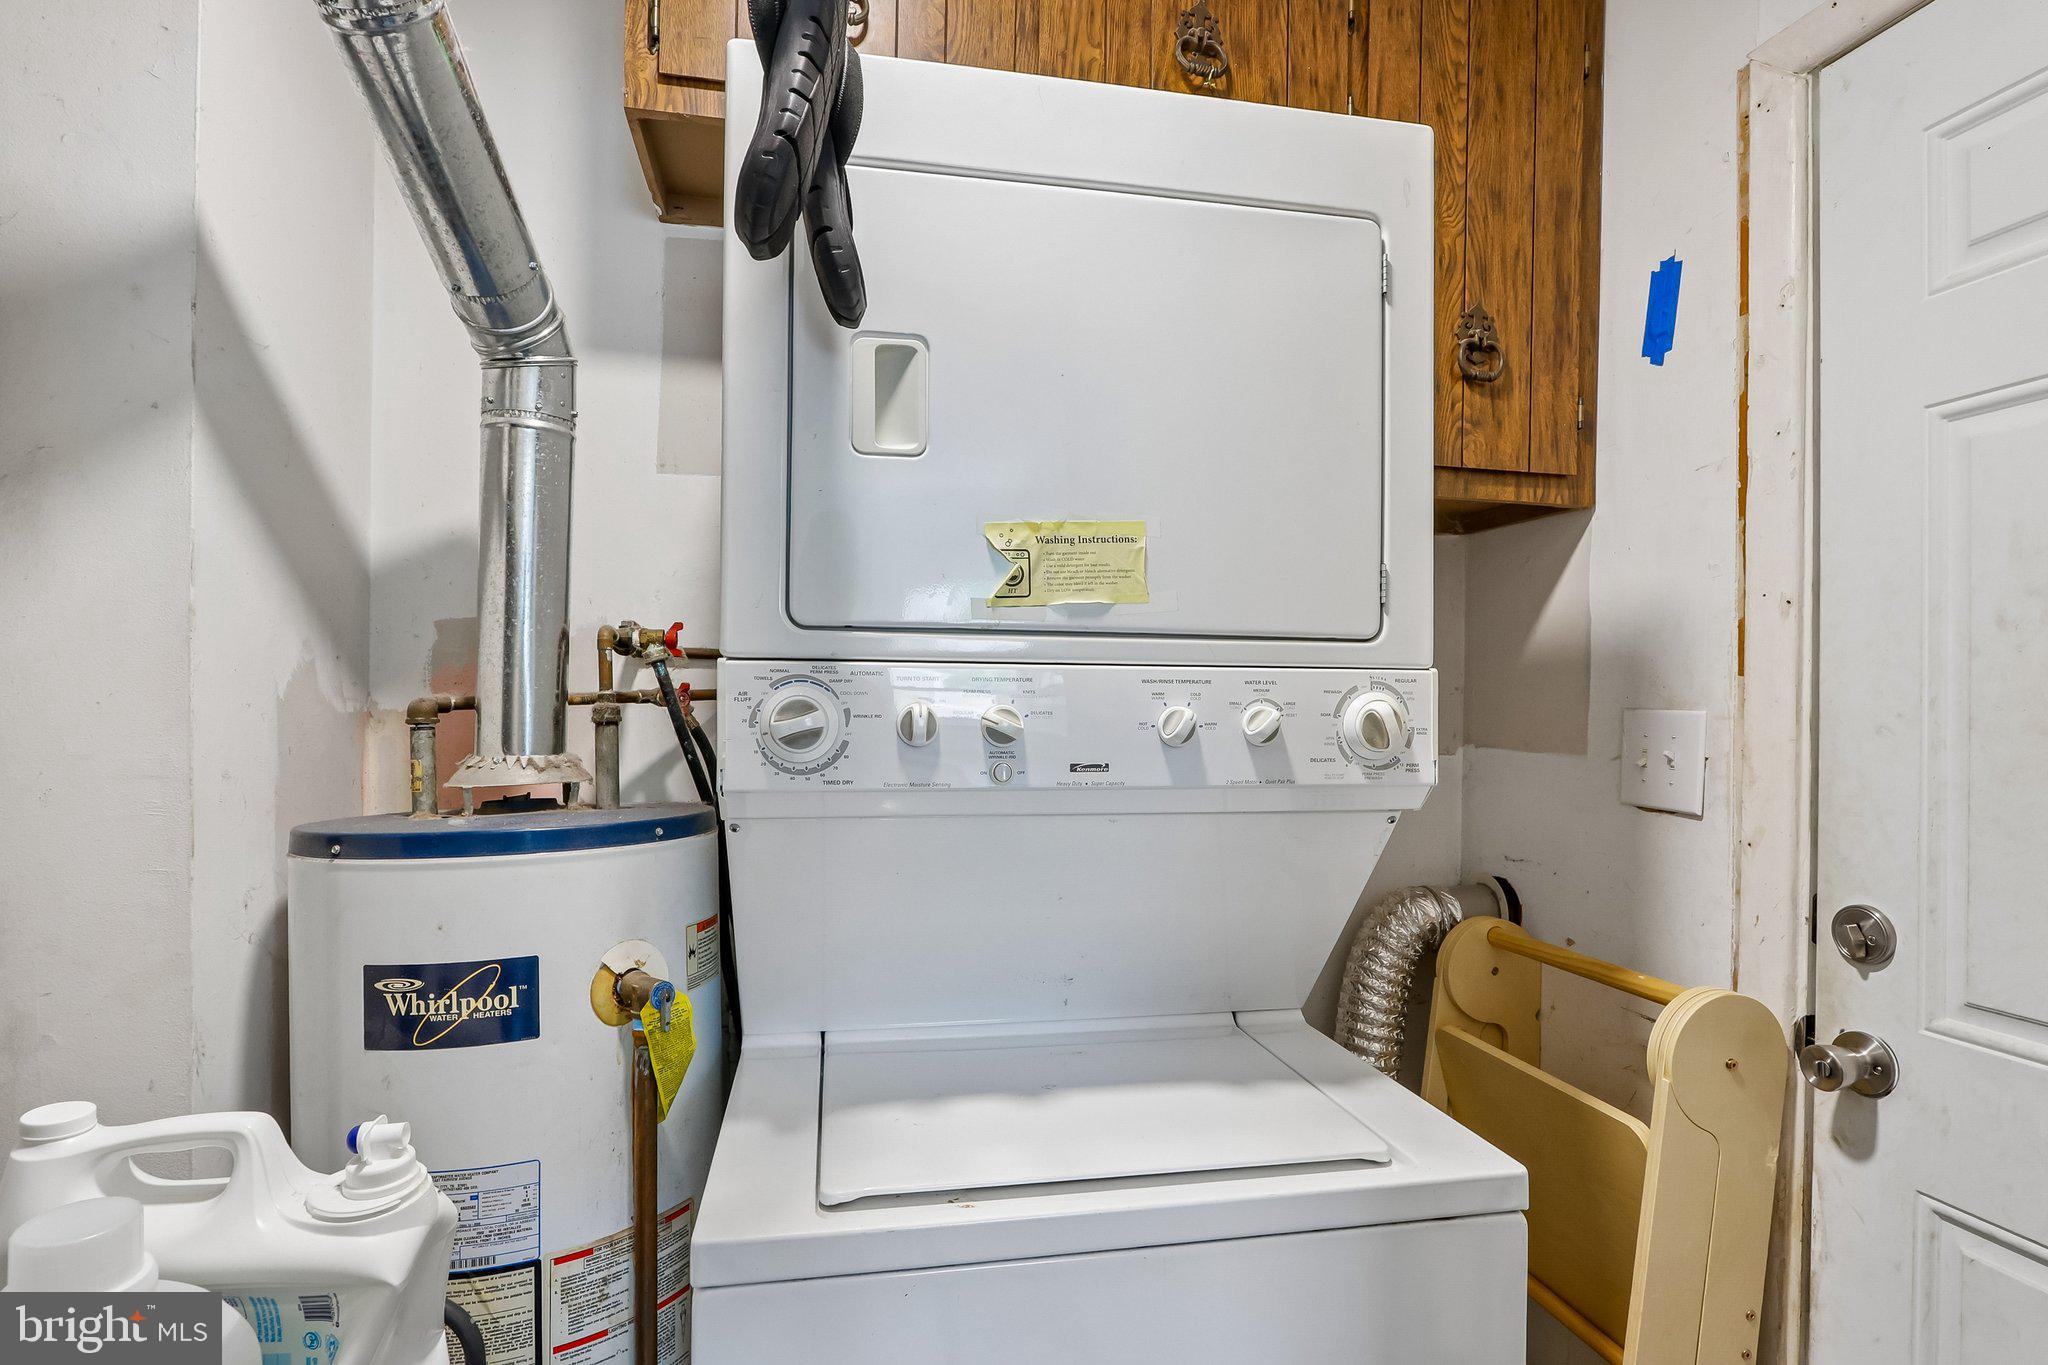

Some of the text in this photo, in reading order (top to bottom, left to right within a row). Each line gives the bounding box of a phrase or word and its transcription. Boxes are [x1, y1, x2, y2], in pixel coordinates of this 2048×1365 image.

[1035, 535, 1138, 546] Washing Instructions:
[383, 986, 519, 1020] Whirlpool
[430, 1009, 512, 1022] WATER HEATERS
